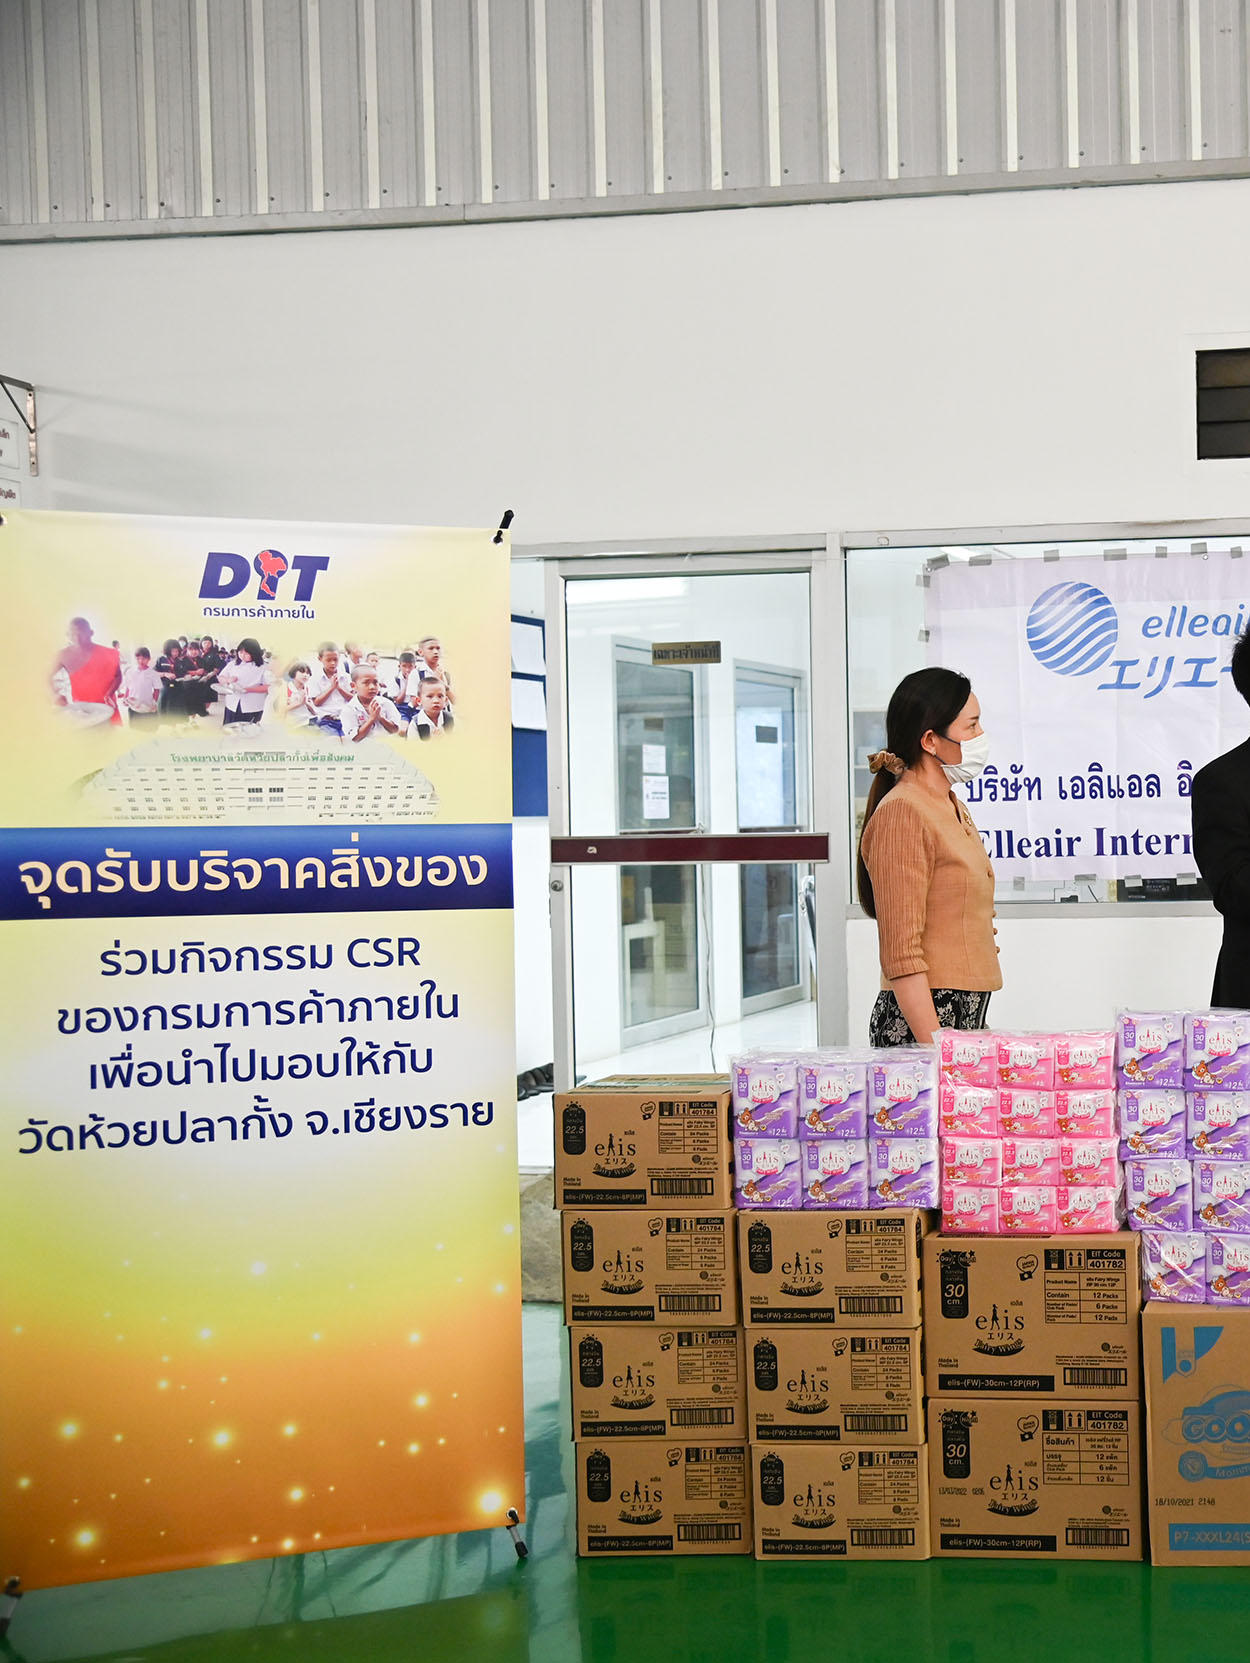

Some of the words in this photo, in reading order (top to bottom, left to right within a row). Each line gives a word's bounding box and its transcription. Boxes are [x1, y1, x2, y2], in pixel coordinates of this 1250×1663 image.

[203, 605, 315, 619] กรมการค้าภายใน
[966, 764, 1042, 802] บริษัท
[1058, 762, 1161, 799] เอลิแอล
[18, 832, 488, 910] จุดรับบริจาคสิ่งของ
[100, 940, 333, 976] ร่วมกิจกรรม
[347, 937, 421, 968] CSR
[57, 980, 459, 1034] ของกรมการค้าภายใน
[90, 1036, 432, 1090] เพื่อนำไปมอบให้กับ
[18, 1096, 292, 1154] วัดห้วยปลากั้ง
[306, 1099, 494, 1135] จ.เชียงราย
[751, 1244, 770, 1252] 22.5
[944, 1284, 964, 1298] 30
[987, 1332, 1014, 1340] エリス
[946, 1444, 966, 1457] 30
[589, 1473, 609, 1481] 22.5
[1002, 1493, 1028, 1501] エリス
